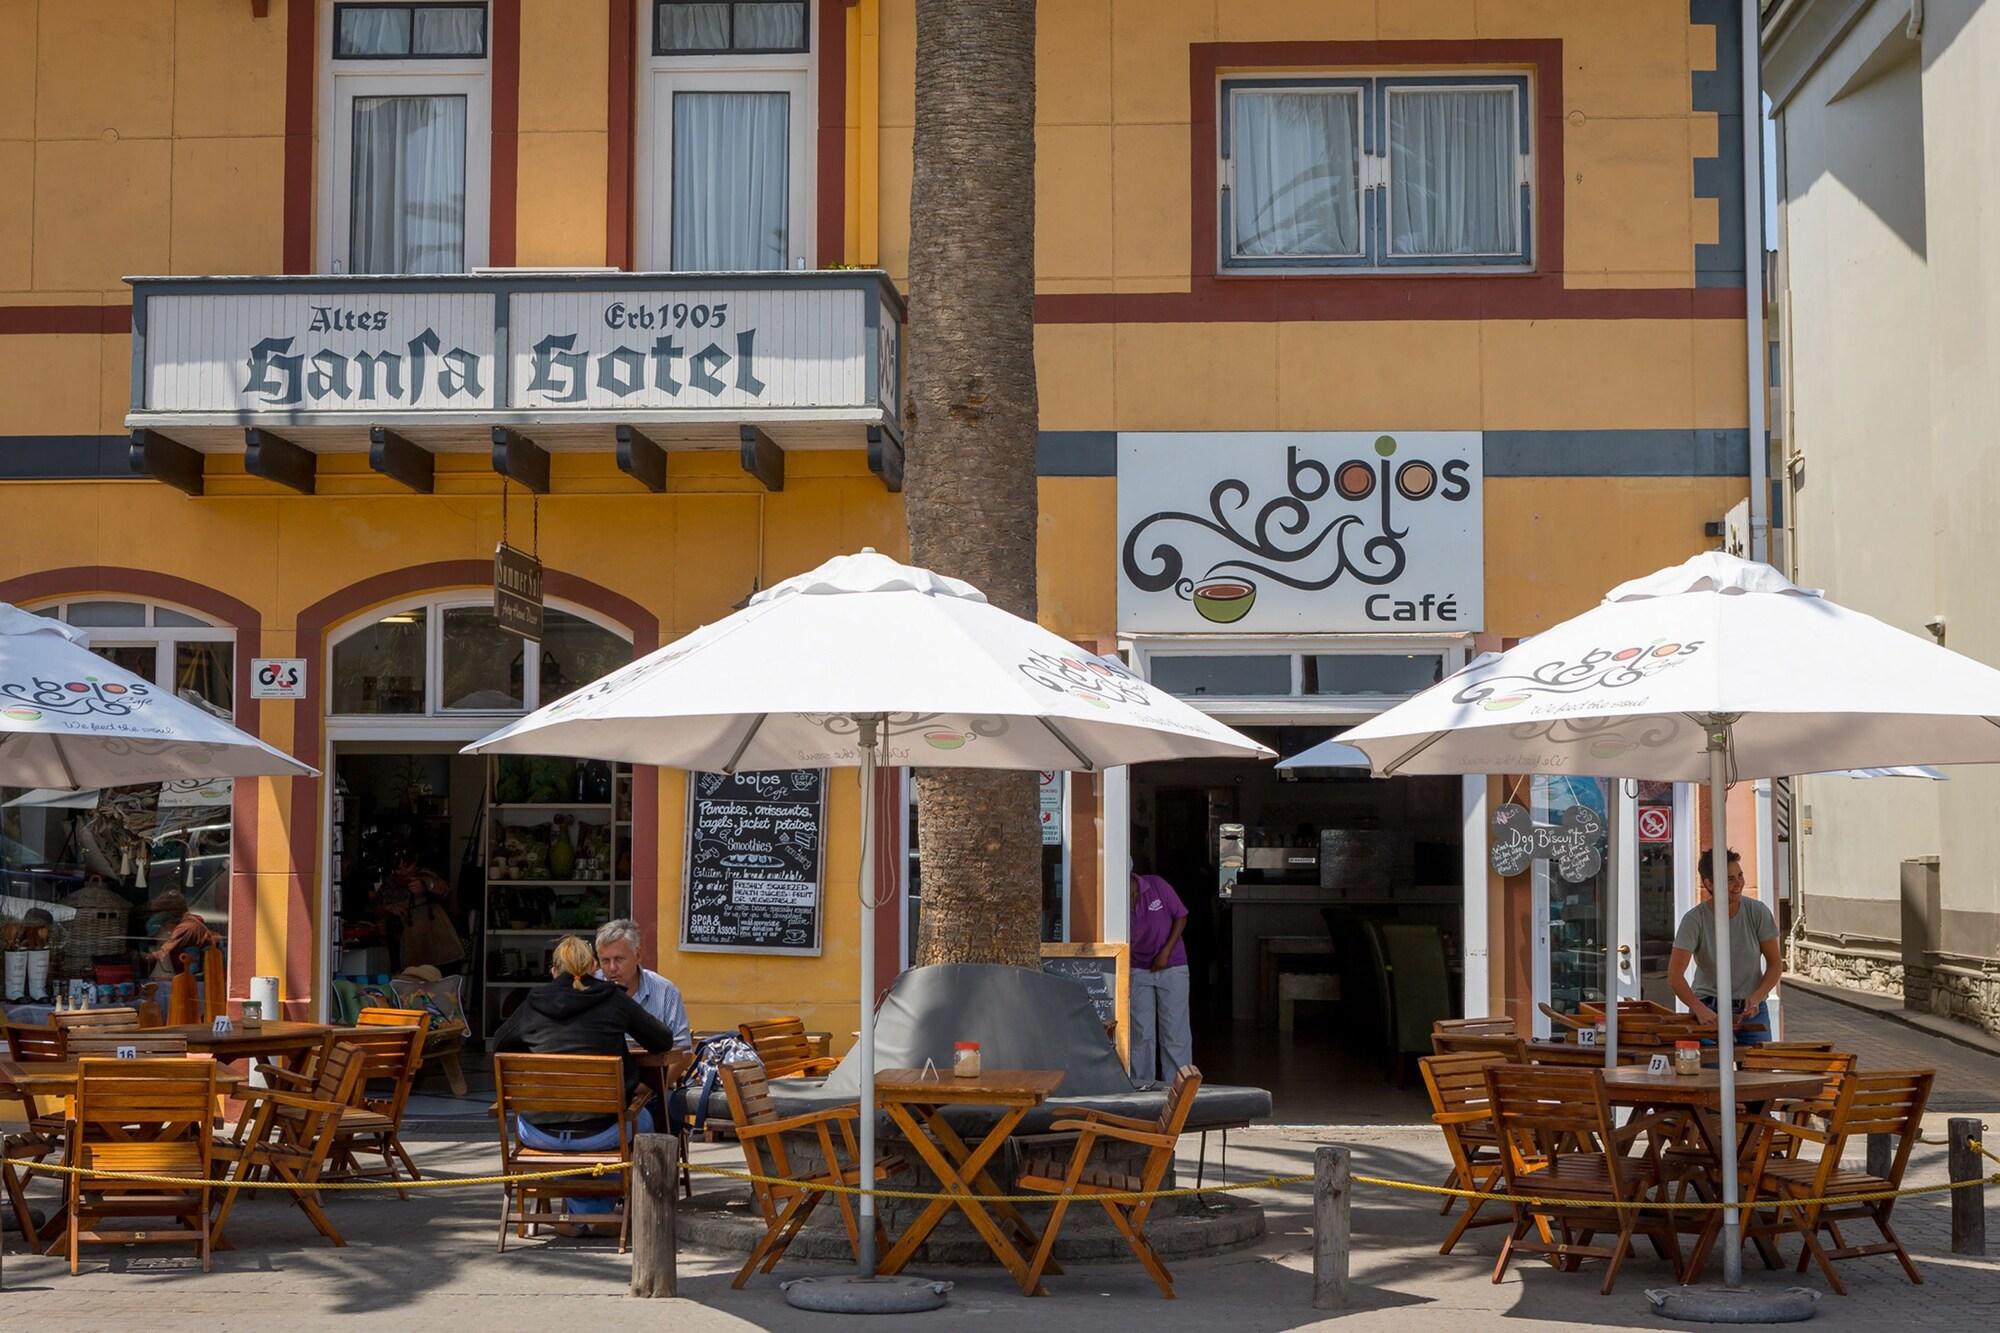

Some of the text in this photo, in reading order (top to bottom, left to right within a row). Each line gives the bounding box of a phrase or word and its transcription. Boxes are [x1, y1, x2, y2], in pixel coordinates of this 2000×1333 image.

[309, 306, 388, 332] Altes
[526, 327, 767, 403] Hotel
[1287, 434, 1471, 540] bojos
[1365, 593, 1457, 622] Café
[1580, 637, 1705, 674] bojos
[258, 664, 298, 688] G4S
[31, 675, 150, 704] bojos
[734, 817, 771, 836] jacket
[727, 837, 773, 852] Smoothies
[1509, 826, 1586, 855] Dog Biscuits
[215, 1020, 226, 1031] 17
[1580, 1031, 1594, 1042] 12
[118, 1050, 134, 1059] 16
[1651, 1058, 1662, 1070] 13
